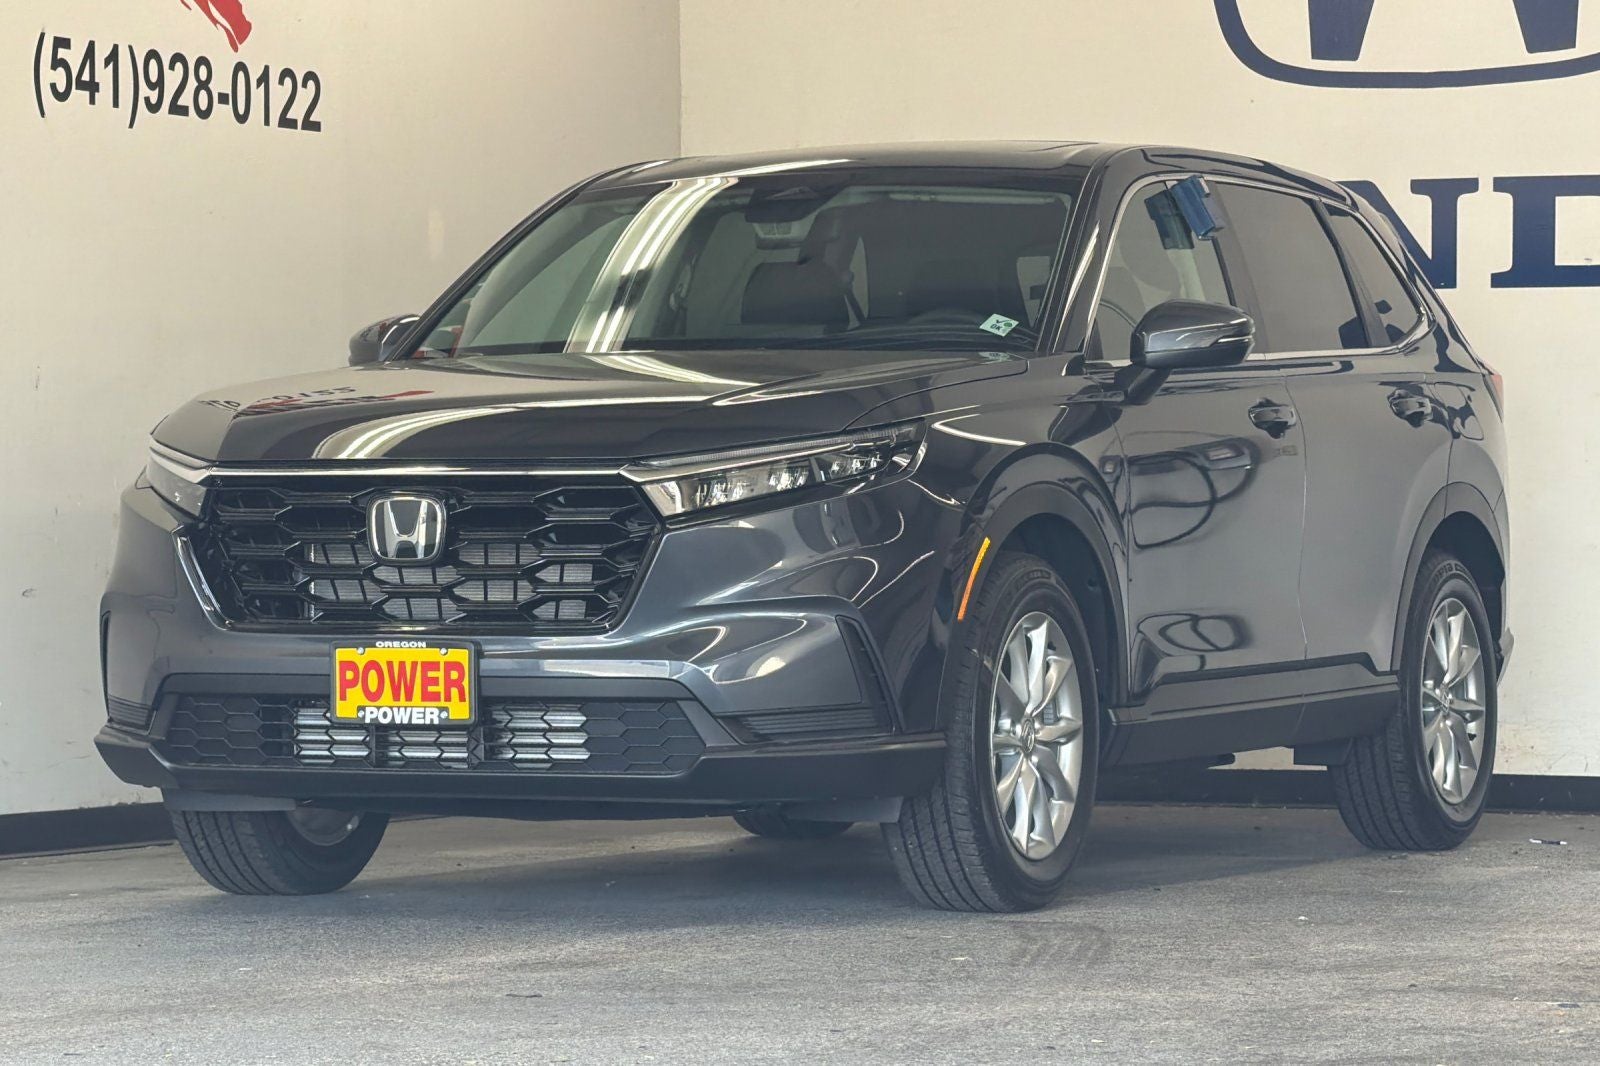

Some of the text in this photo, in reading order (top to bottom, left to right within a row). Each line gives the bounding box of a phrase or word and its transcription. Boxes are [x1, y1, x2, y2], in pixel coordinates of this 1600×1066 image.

[33, 31, 322, 132] (541)928-0122
[375, 640, 427, 649] OREGON
[338, 659, 467, 703] POWER
[364, 706, 440, 725] POWER
